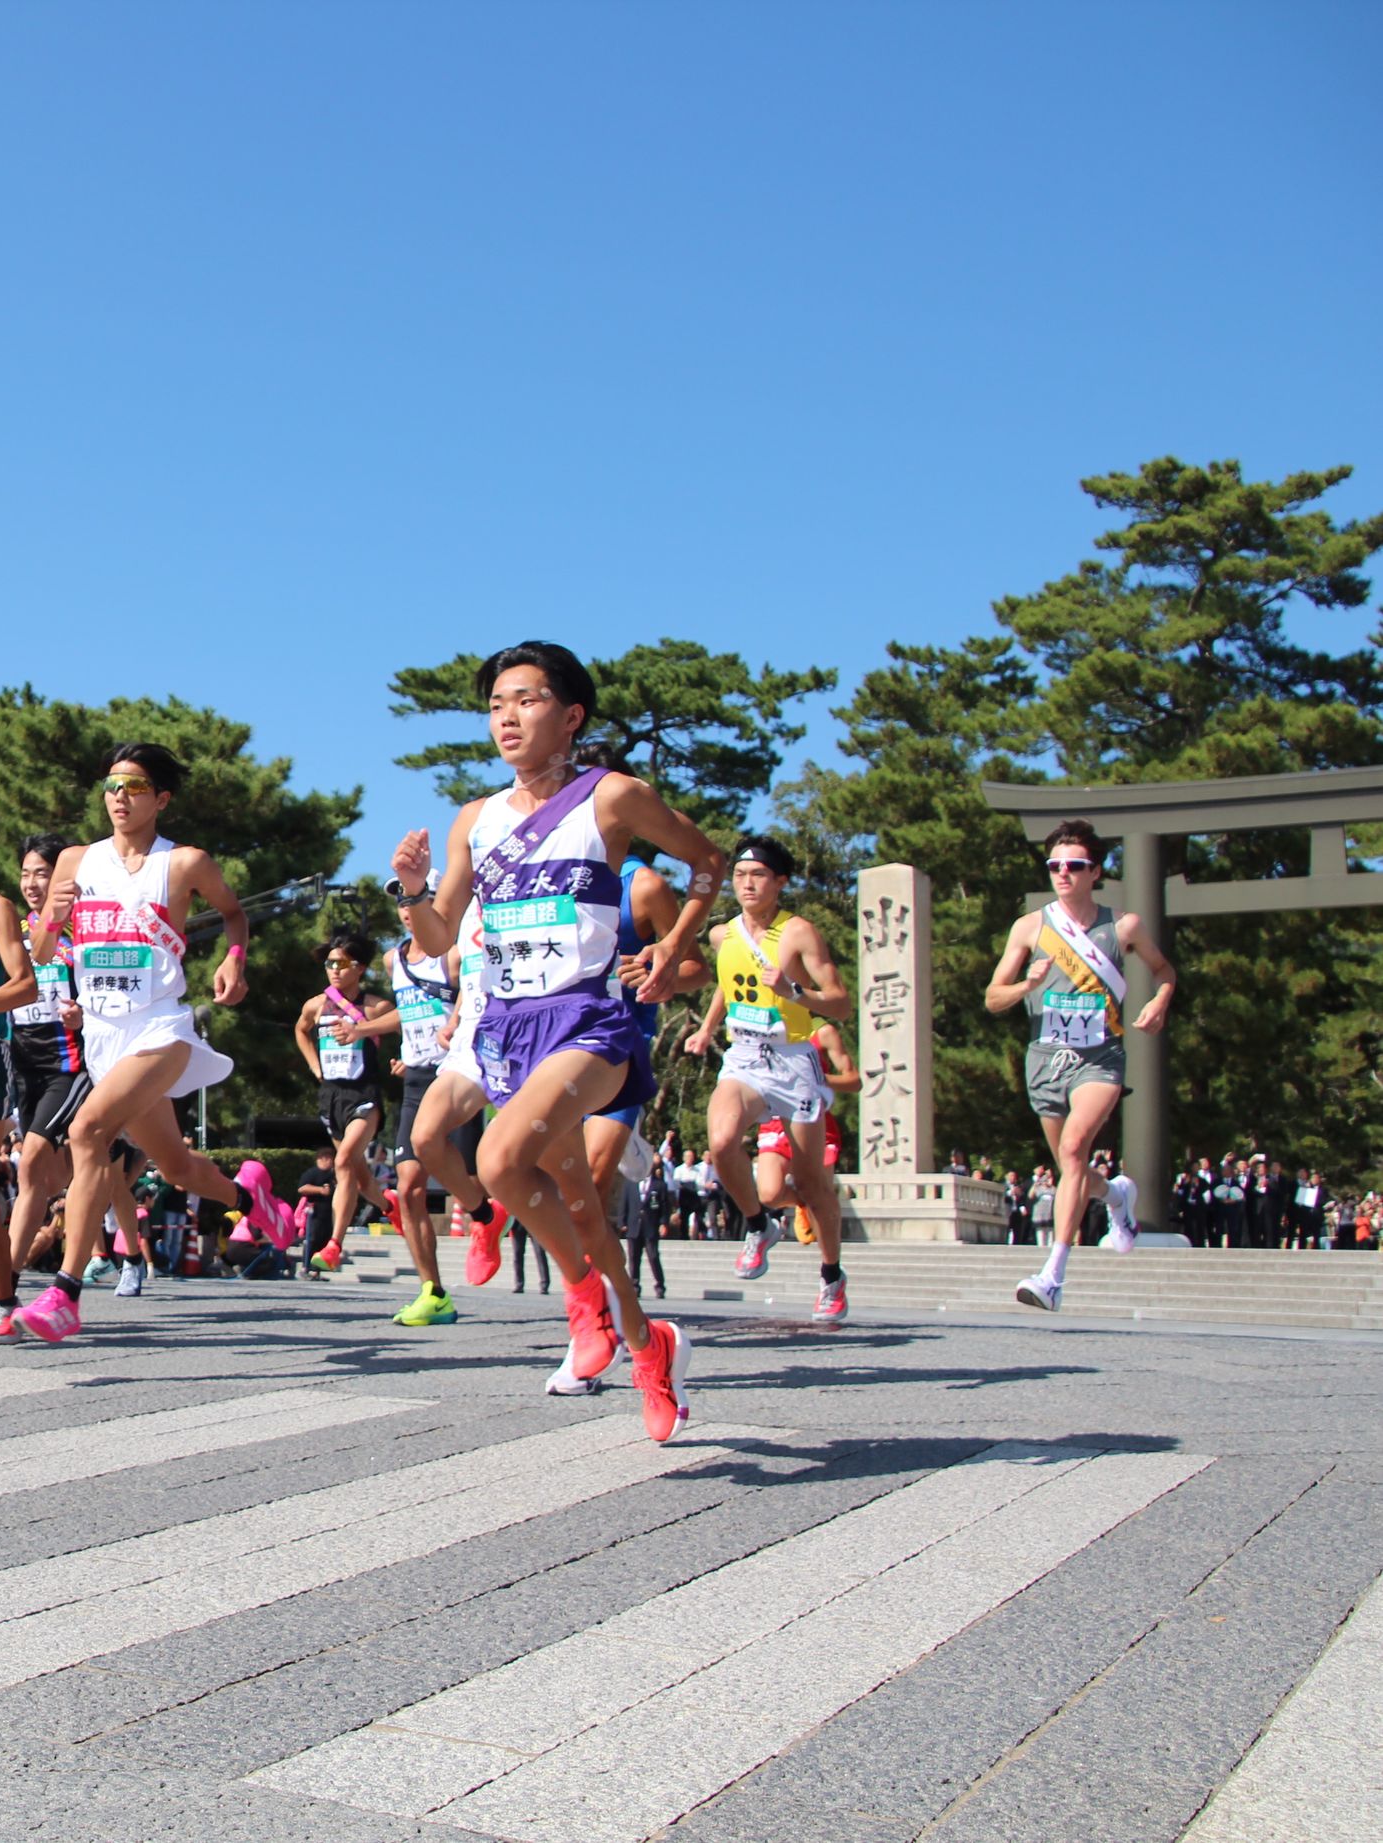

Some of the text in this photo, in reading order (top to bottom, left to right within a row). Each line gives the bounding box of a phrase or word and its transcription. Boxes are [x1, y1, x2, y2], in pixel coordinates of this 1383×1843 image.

[483, 902, 557, 927] 前田道路
[485, 937, 564, 965] 駒澤大
[500, 968, 548, 993] 5-1
[90, 995, 132, 1014] 17-1
[862, 896, 913, 1170] 出雲大社
[1049, 1013, 1093, 1029] IVY
[1051, 1030, 1089, 1045] 21-1
